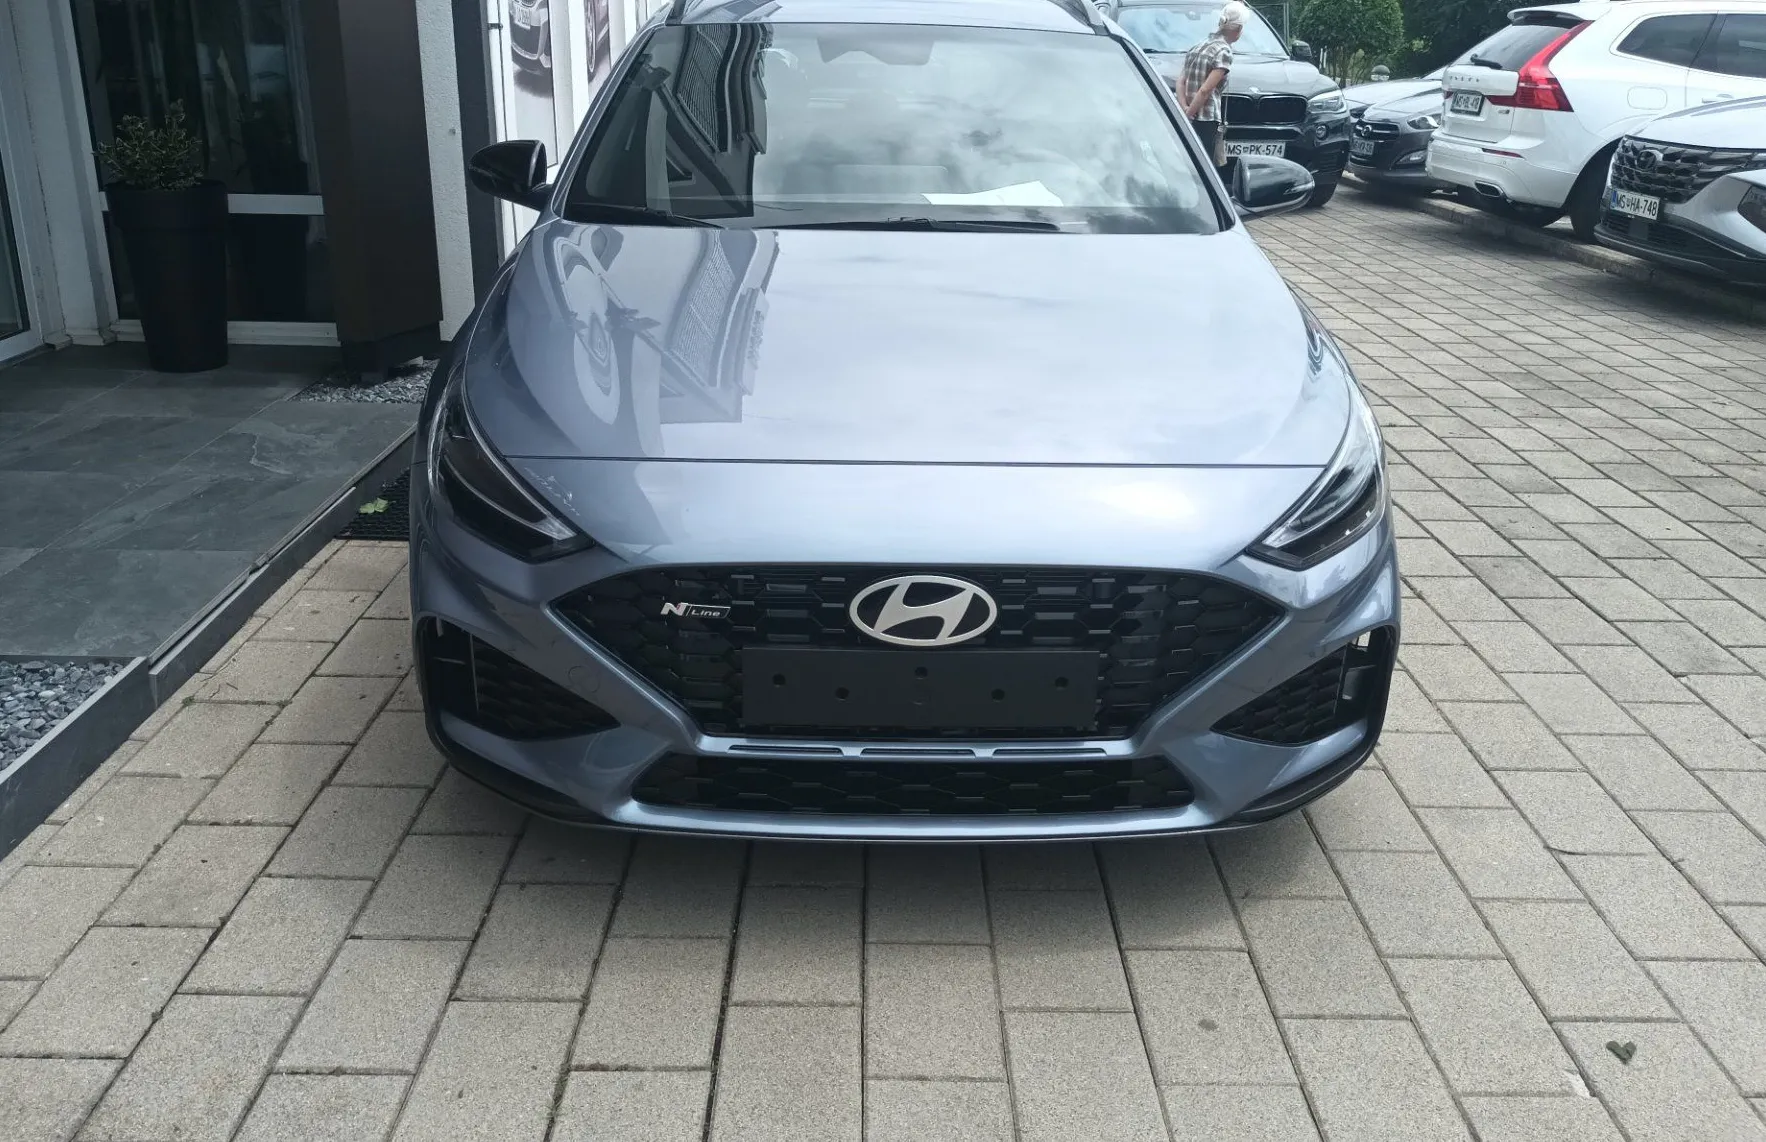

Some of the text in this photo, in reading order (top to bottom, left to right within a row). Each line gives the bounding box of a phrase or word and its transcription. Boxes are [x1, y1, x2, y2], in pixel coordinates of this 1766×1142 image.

[1249, 144, 1283, 156] PK-574
[660, 602, 721, 617] N Line
